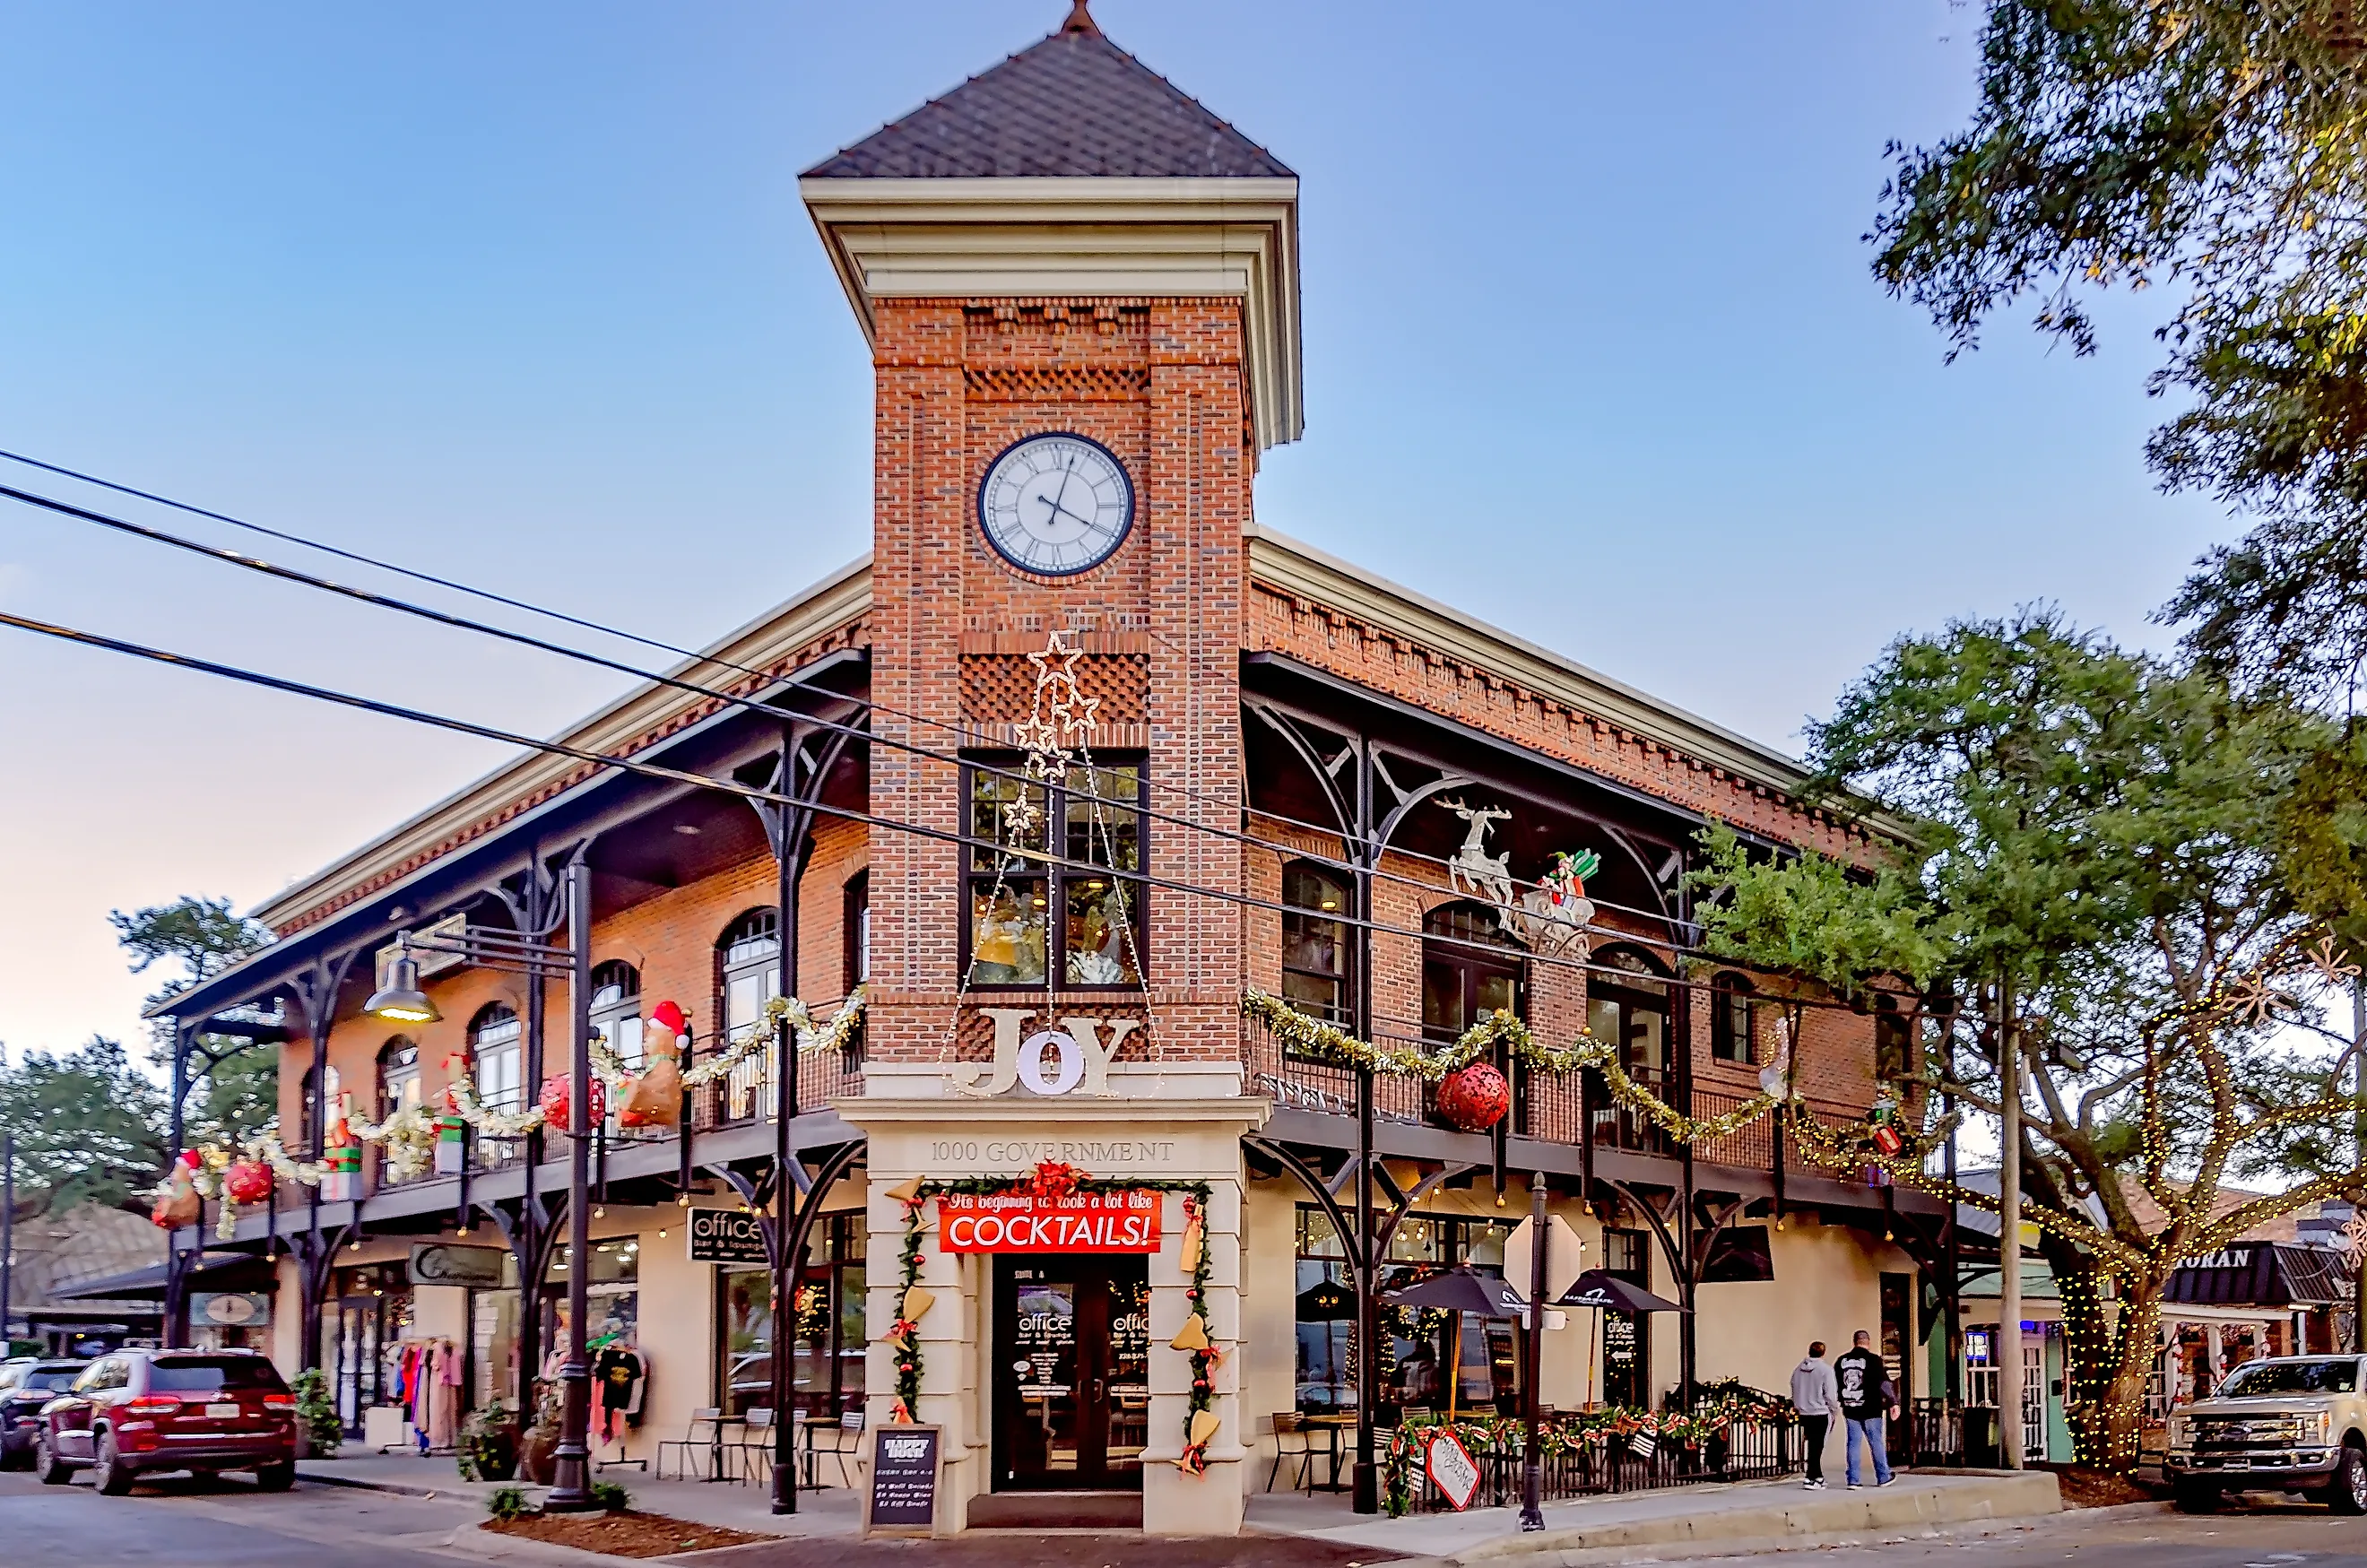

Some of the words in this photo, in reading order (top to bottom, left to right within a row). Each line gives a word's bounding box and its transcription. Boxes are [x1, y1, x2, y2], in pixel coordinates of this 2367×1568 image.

[950, 1007, 1140, 1098] JOY
[932, 1141, 978, 1162] 1000
[986, 1141, 1175, 1163] GOVERNMENT
[977, 1194, 1033, 1214] beginning
[1090, 1197, 1100, 1209] a
[1105, 1191, 1123, 1209] lot
[1128, 1191, 1153, 1209] like
[694, 1212, 762, 1240] office
[949, 1215, 1151, 1247] COCKTAILS!
[715, 1239, 725, 1249] &
[1019, 1312, 1072, 1332] office
[1113, 1312, 1149, 1332] offic
